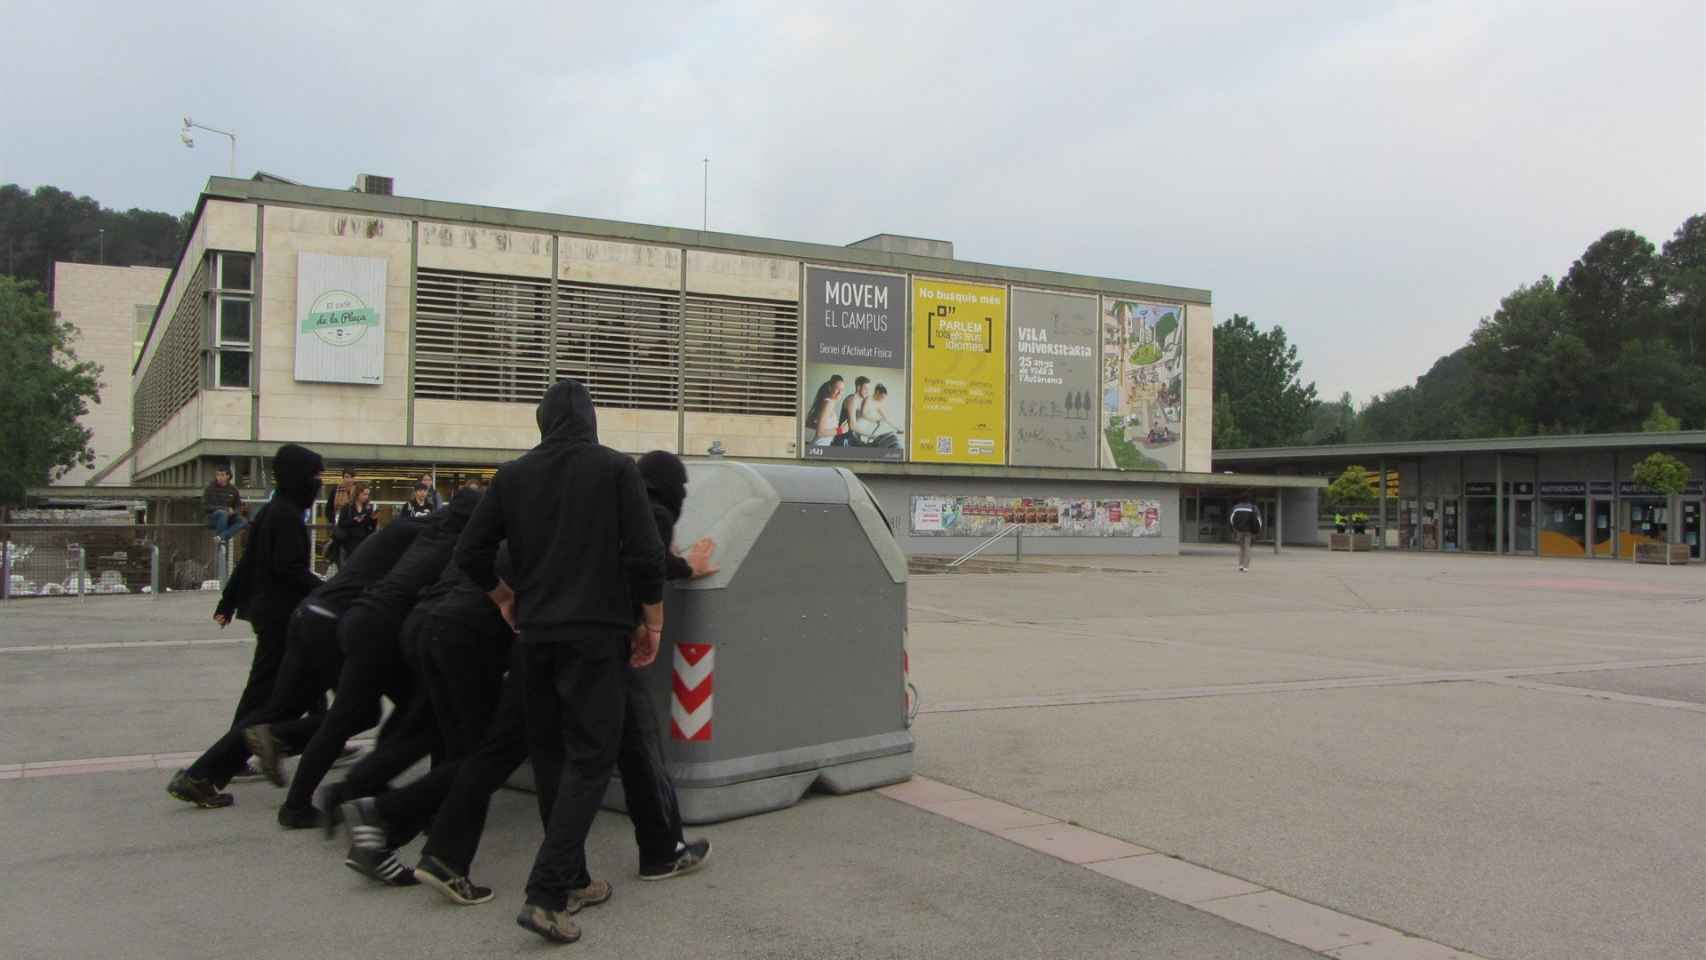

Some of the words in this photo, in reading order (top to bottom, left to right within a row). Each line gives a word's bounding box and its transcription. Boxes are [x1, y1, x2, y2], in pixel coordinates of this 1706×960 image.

[825, 280, 888, 310] MOVEM
[919, 286, 935, 299] No
[825, 310, 838, 328] EL
[841, 311, 888, 332] CAMPUS
[938, 319, 982, 335] PARLEM
